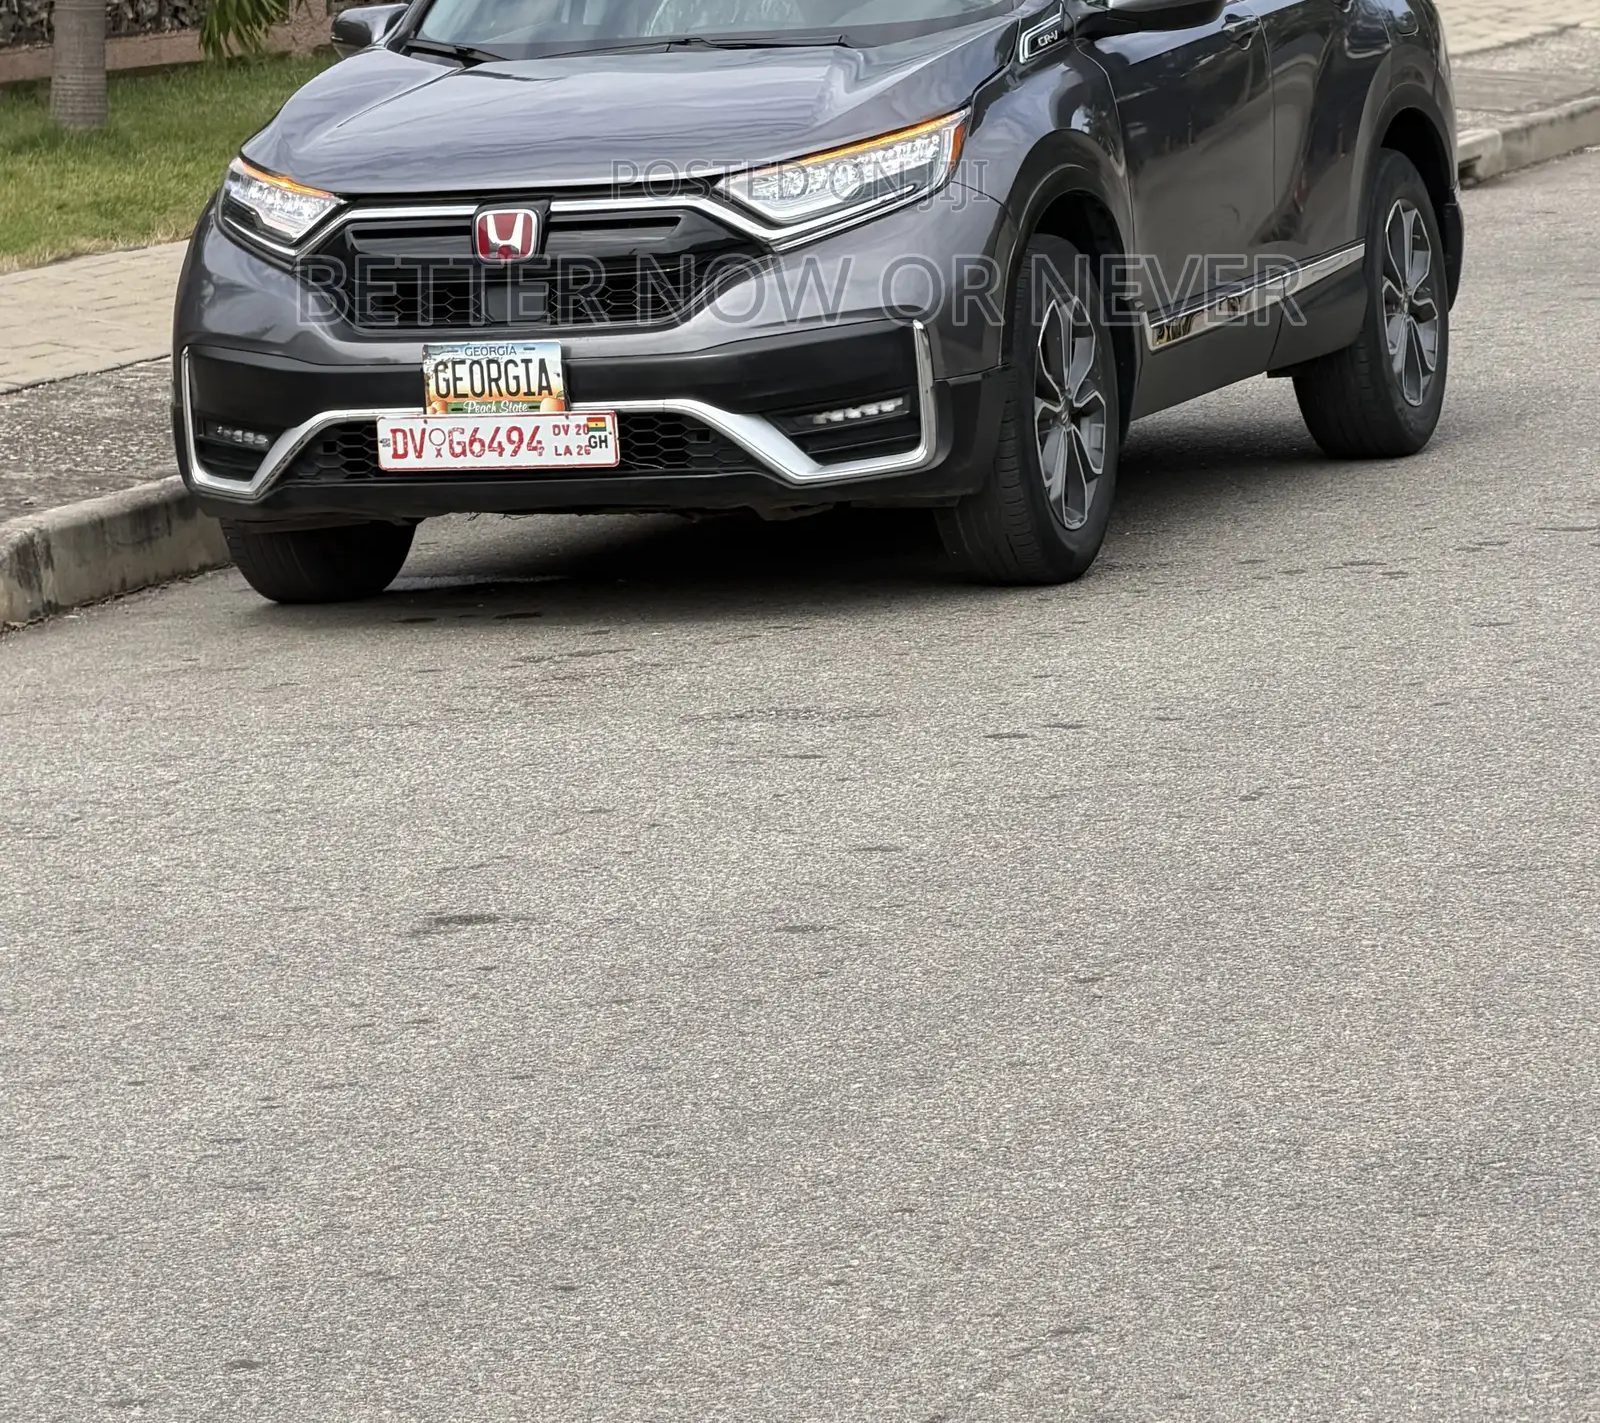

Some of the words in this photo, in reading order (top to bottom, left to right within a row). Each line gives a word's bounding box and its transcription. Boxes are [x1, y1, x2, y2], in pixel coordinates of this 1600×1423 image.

[1038, 30, 1058, 46] CR-V
[464, 345, 517, 357] GEORGIA
[434, 358, 553, 398] GEORGIA
[463, 400, 497, 414] Peach
[500, 400, 528, 413] State
[552, 424, 570, 436] DV
[574, 423, 590, 436] 20
[390, 427, 426, 459] DV
[447, 426, 545, 458] G6494
[588, 435, 608, 449] GH
[554, 445, 573, 456] LA
